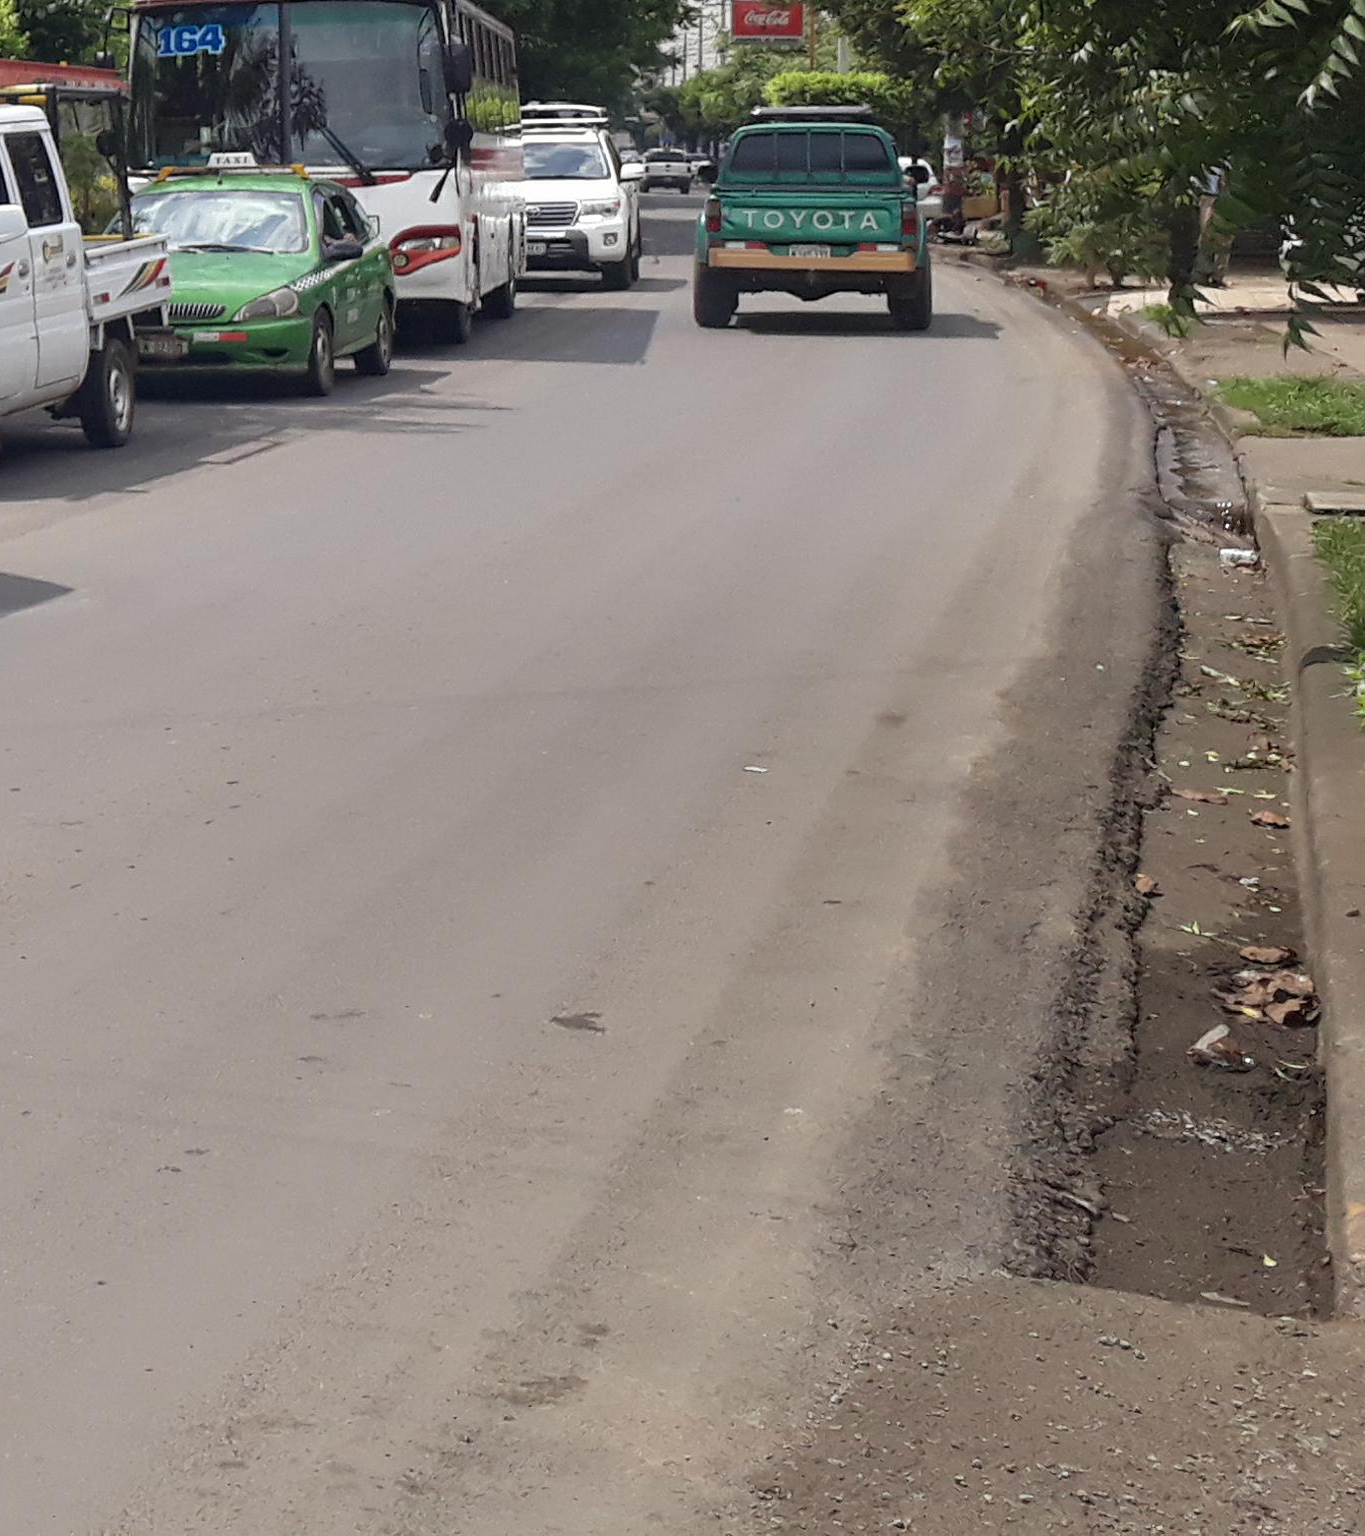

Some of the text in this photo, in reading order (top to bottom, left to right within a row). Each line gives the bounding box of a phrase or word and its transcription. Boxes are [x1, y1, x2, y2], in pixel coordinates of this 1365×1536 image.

[157, 24, 225, 57] 164
[214, 155, 249, 165] TAXI
[742, 210, 879, 230] TOYOTA
